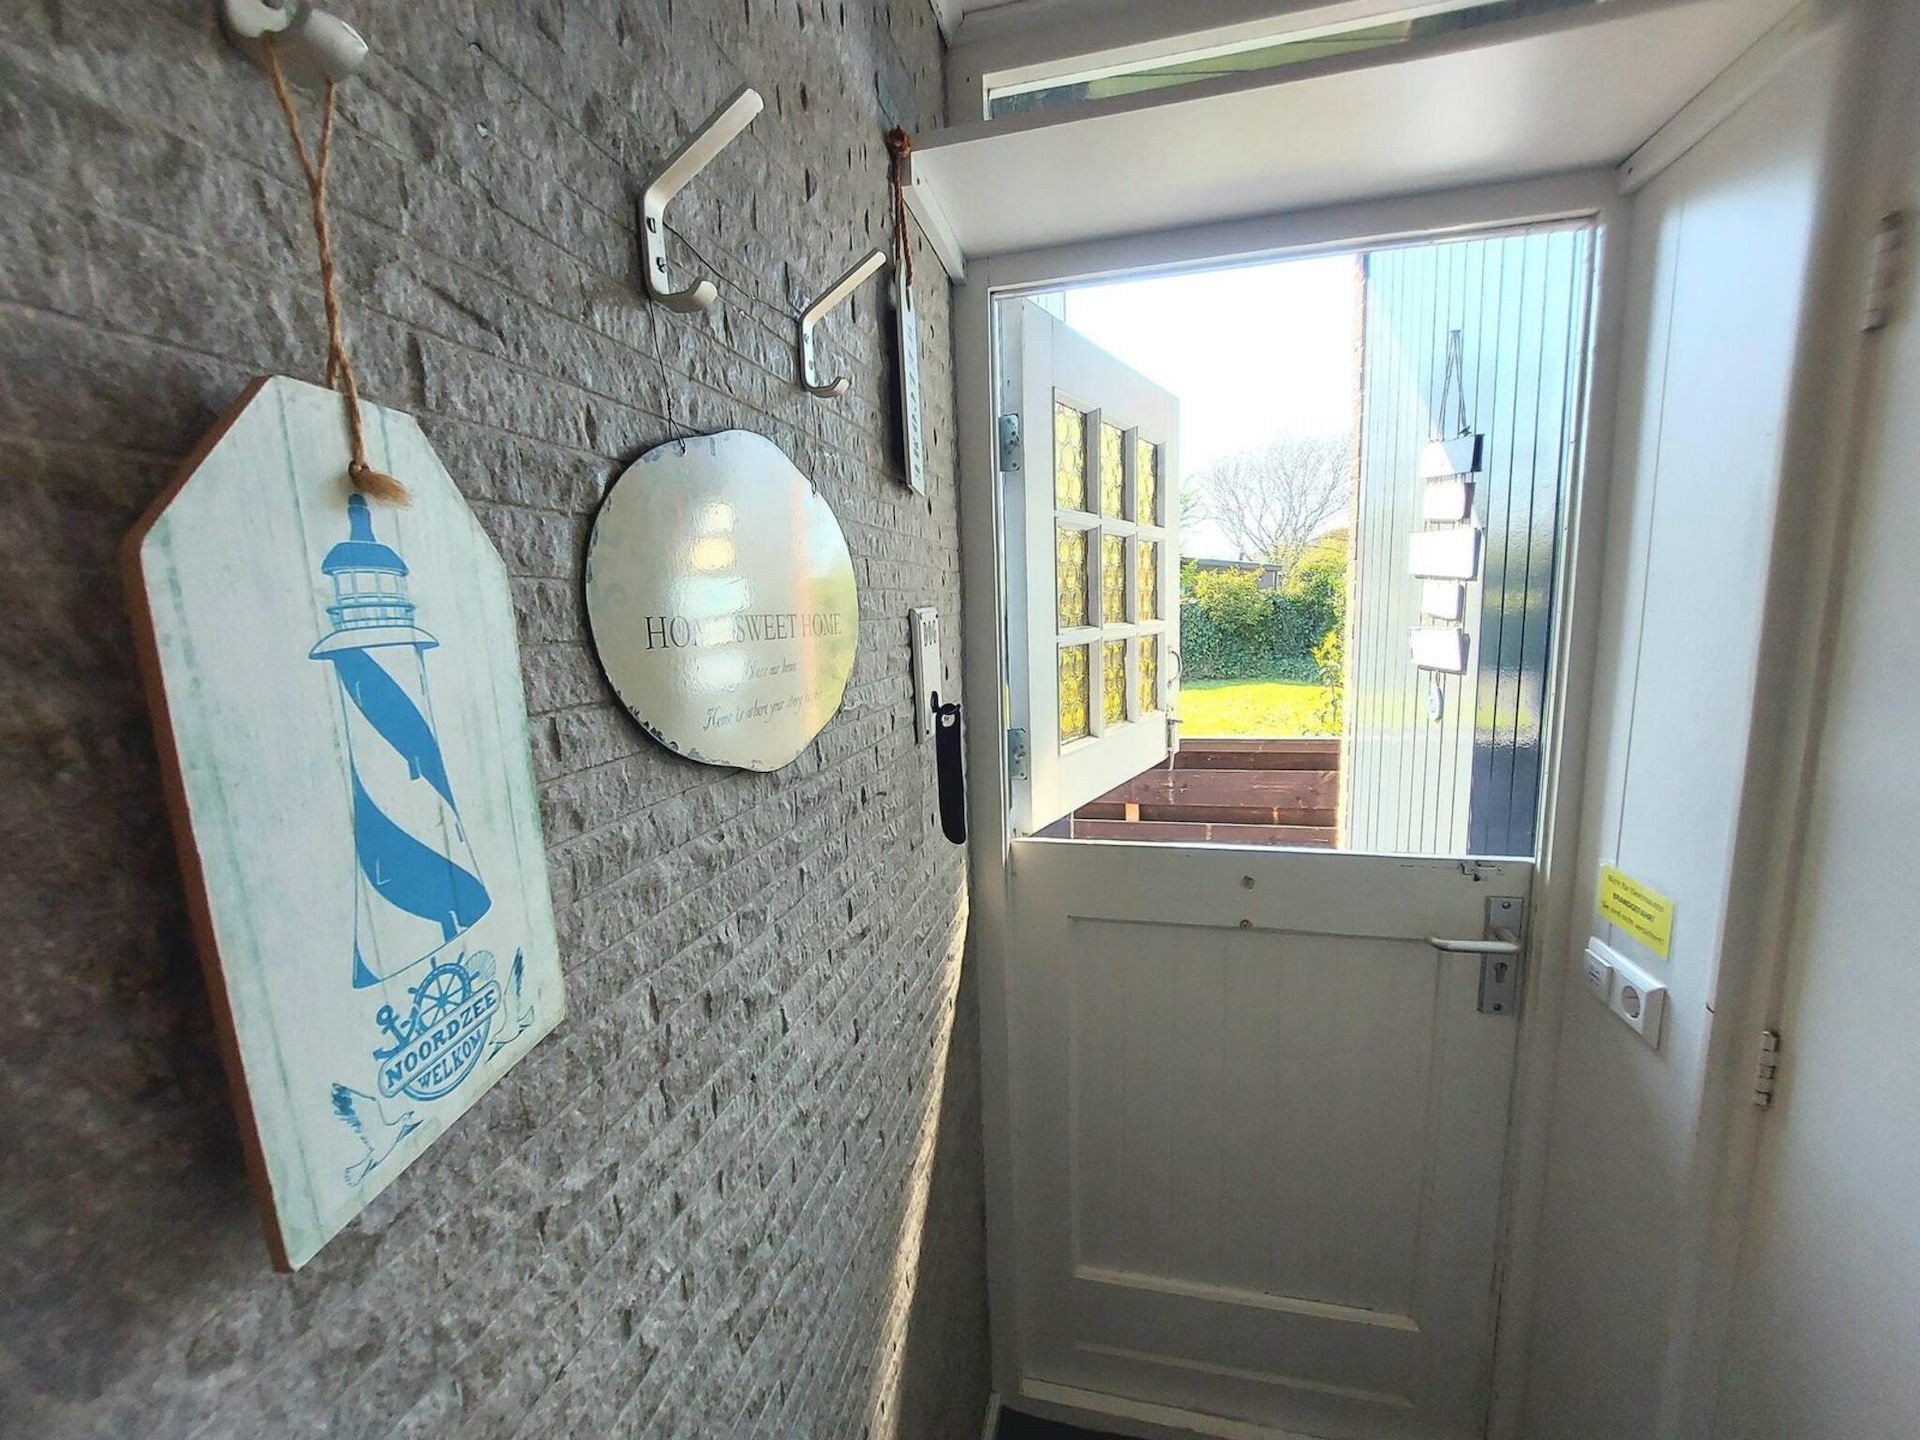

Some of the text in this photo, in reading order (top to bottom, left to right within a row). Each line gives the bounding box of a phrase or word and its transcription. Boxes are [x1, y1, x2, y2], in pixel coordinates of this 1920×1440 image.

[644, 613, 842, 650] HO SWEET HOME
[384, 988, 496, 1089] NOORDZEE
